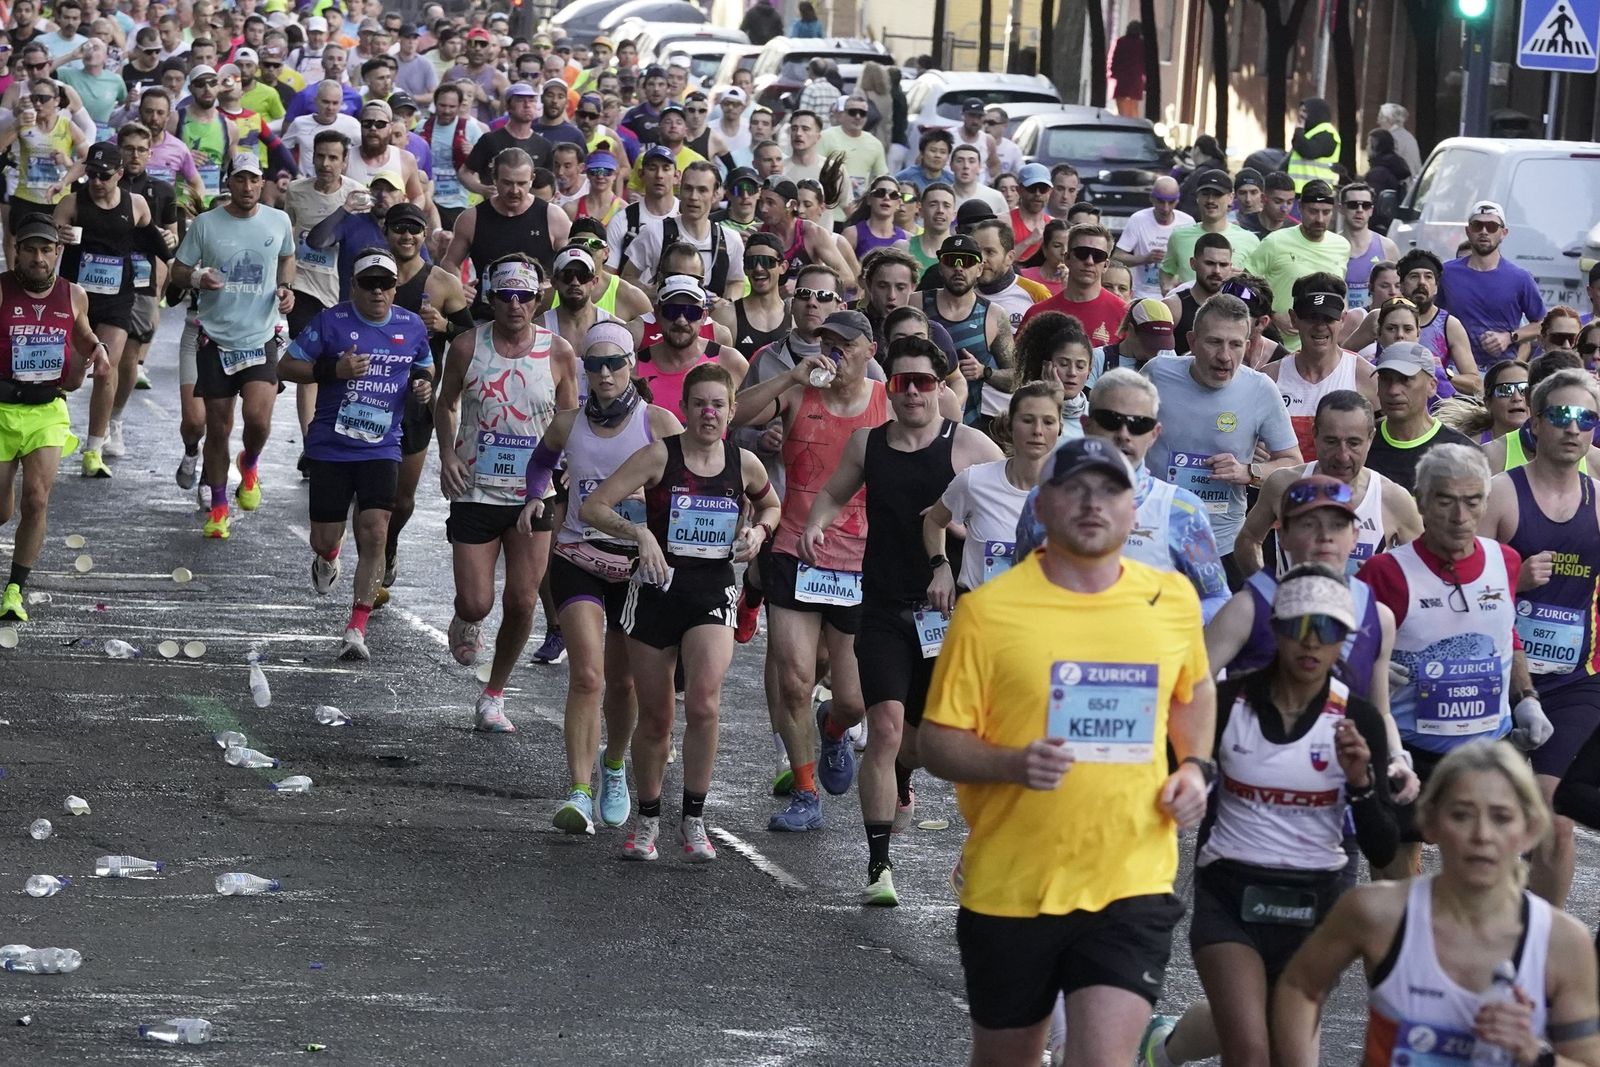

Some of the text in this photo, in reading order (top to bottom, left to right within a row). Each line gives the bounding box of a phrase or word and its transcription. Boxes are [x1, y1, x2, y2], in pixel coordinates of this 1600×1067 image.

[94, 256, 120, 265] ZURICH
[31, 336, 59, 344] ZURICH
[15, 357, 63, 370] LUIS JOSÉ
[368, 364, 392, 377] HILE
[346, 380, 399, 393] GERMAN
[360, 395, 390, 408] ZURICH
[341, 415, 386, 434] GERMAIN
[498, 436, 531, 446] ZURICH
[497, 452, 516, 462] 5483
[493, 462, 517, 475] MEL
[1190, 489, 1229, 501] KARTAL
[695, 499, 731, 509] ZURICH
[695, 517, 714, 527] 7014
[675, 526, 726, 543] CLÀUDIA
[803, 582, 855, 599] JUANMA
[1536, 607, 1575, 621] ZURICH
[1533, 628, 1557, 640] 6877
[1520, 638, 1575, 661] DERICO
[1449, 661, 1495, 675] ZURICH
[1088, 667, 1147, 683] ZURICH
[1447, 685, 1479, 698] 15830
[1087, 698, 1119, 712] 6547
[1437, 700, 1486, 718] DAVID
[1068, 717, 1137, 738] KEMPY
